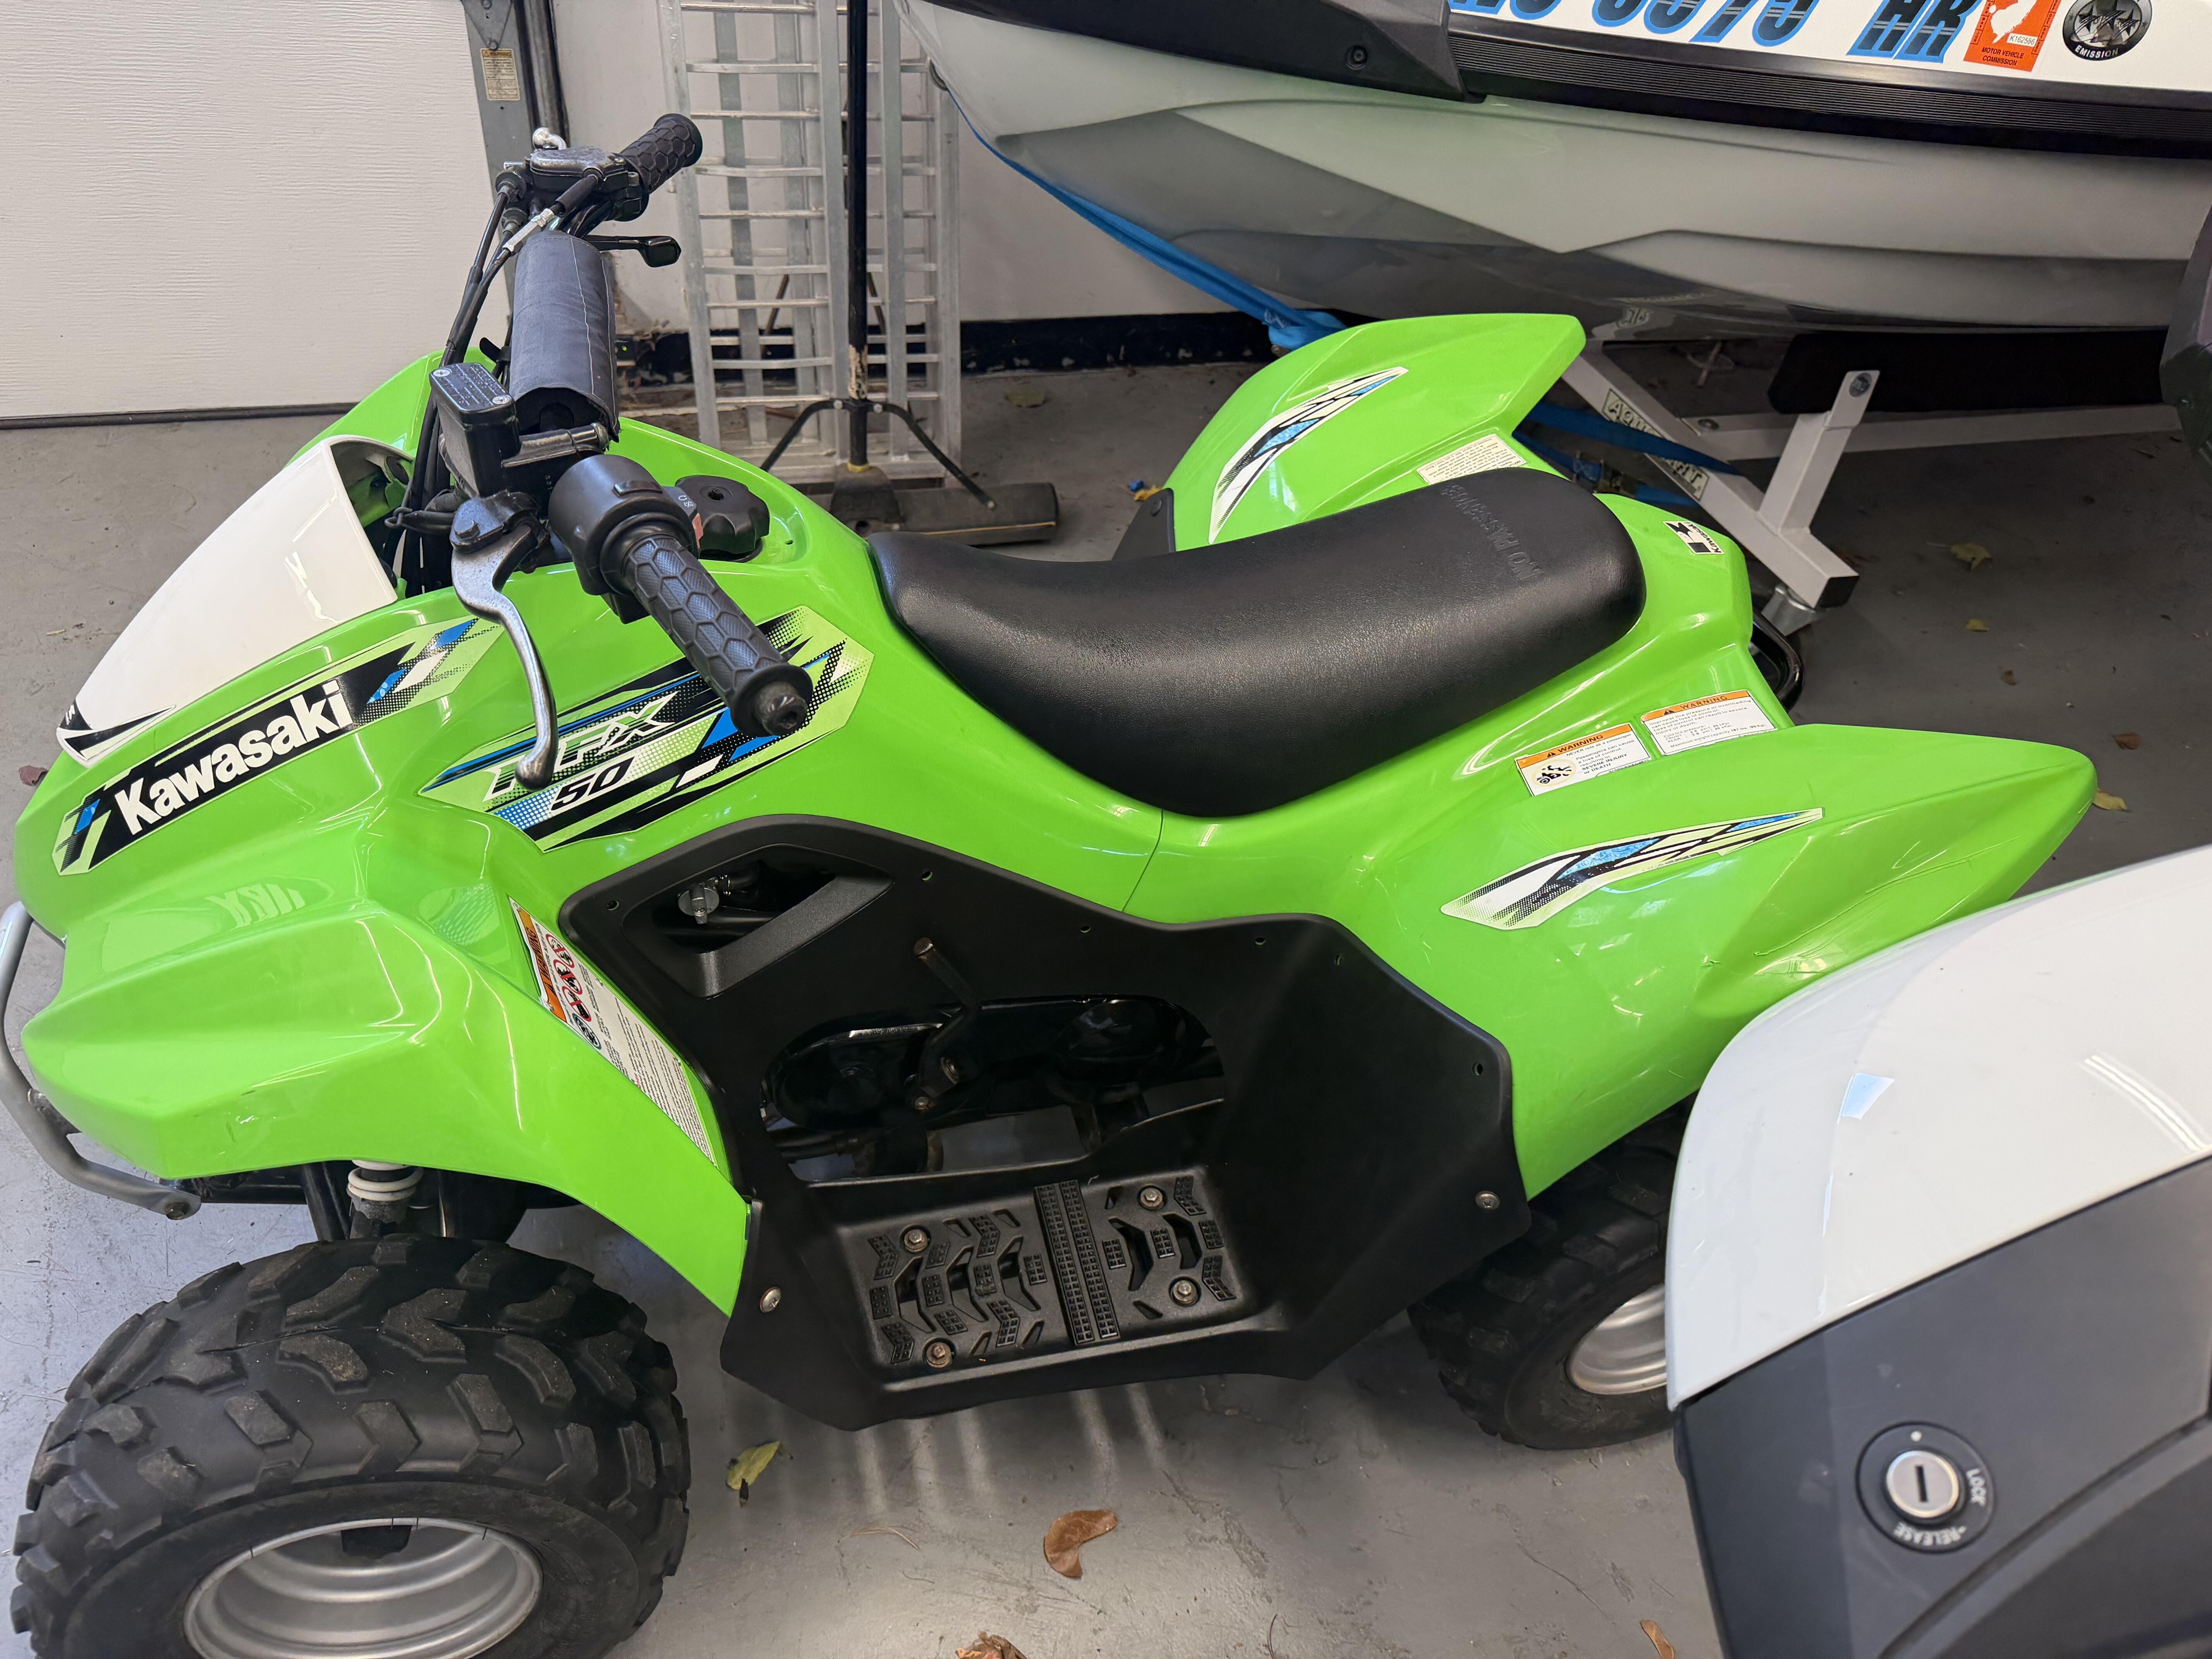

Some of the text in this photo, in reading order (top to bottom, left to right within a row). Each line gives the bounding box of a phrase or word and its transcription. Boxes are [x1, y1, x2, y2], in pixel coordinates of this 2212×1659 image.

[2009, 35, 2036, 45] K162586
[1981, 47, 2024, 59] MOTOR VEHICLE
[2075, 45, 2119, 58] EMISSION
[1982, 55, 2017, 66] COMMISSION
[1683, 522, 1722, 553] Kawasaki
[1680, 696, 1728, 709] WARNING
[1558, 734, 1604, 753] WARNING
[1566, 749, 1584, 757] NEVER
[1606, 733, 1631, 744] passenger
[114, 680, 353, 835] Kawasaki
[1575, 749, 1607, 761] Passengers
[1582, 761, 1605, 771] SEVERE
[1606, 753, 1627, 762] INJURY
[1580, 758, 1605, 768] resulting
[1591, 763, 1611, 772] DEATH
[550, 756, 637, 812] 50
[1966, 1468, 1987, 1506] LOCK
[1893, 1522, 1962, 1546] RELEASE
